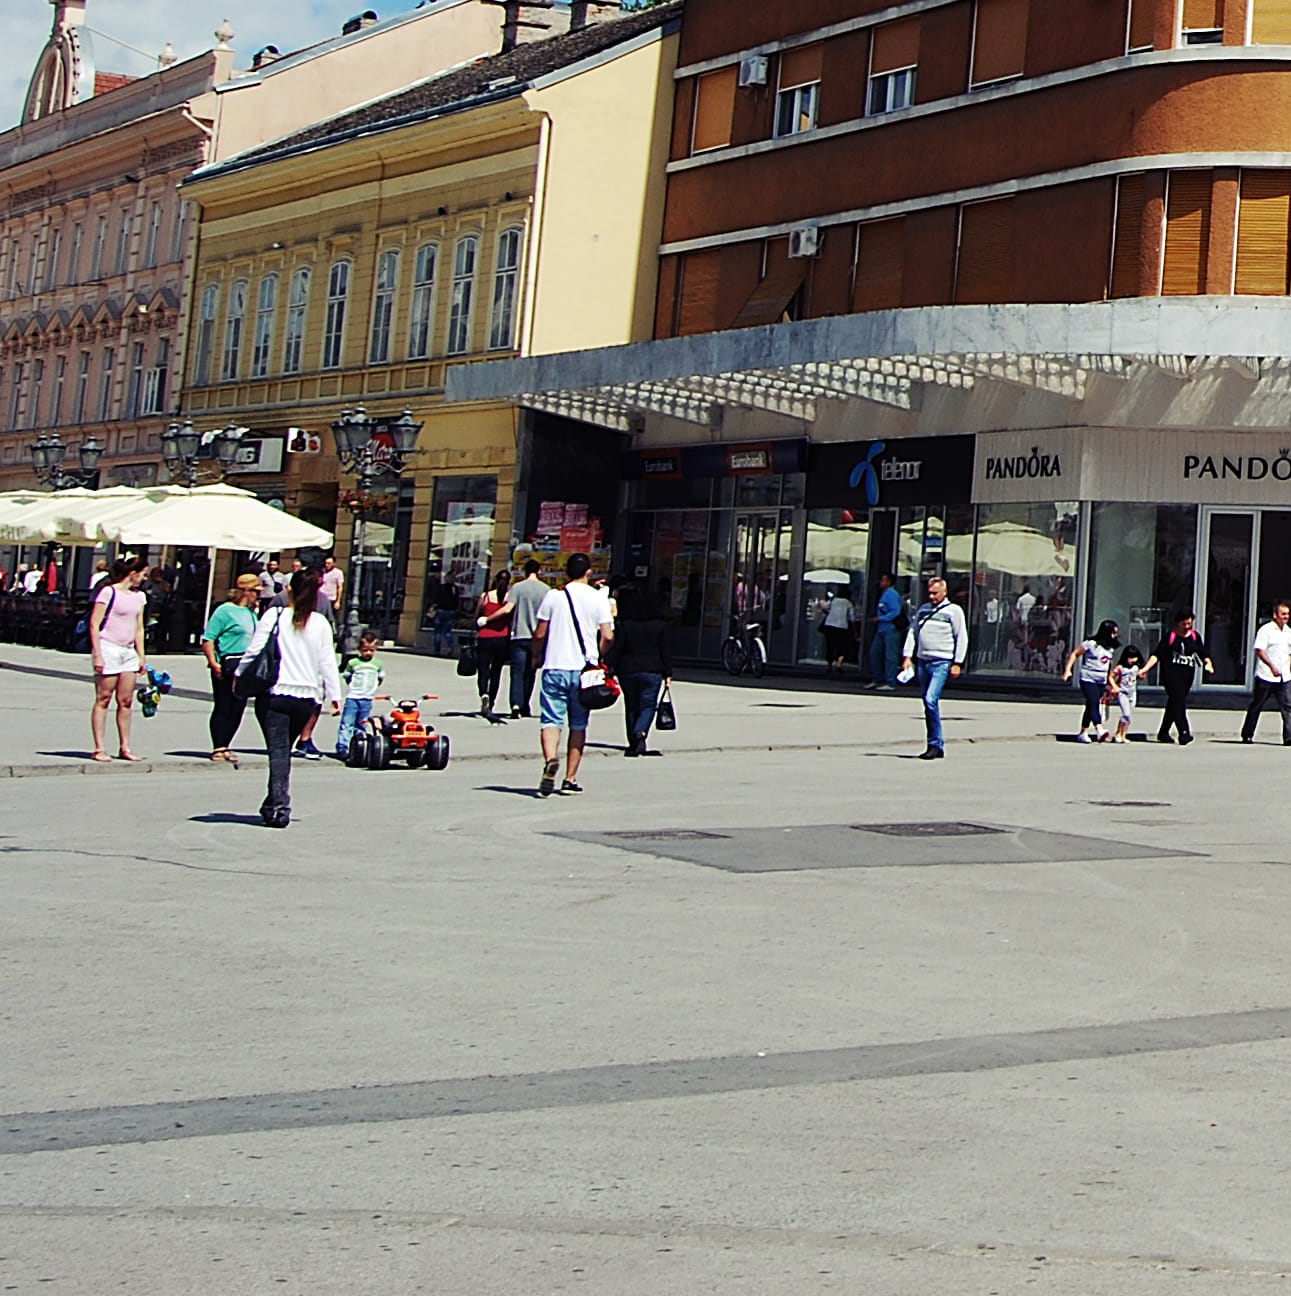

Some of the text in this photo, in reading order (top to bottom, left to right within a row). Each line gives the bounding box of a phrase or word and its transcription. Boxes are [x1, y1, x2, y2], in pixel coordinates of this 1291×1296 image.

[731, 451, 767, 469] Eurobank
[881, 456, 922, 481] telenor
[985, 453, 1062, 480] PANDORA
